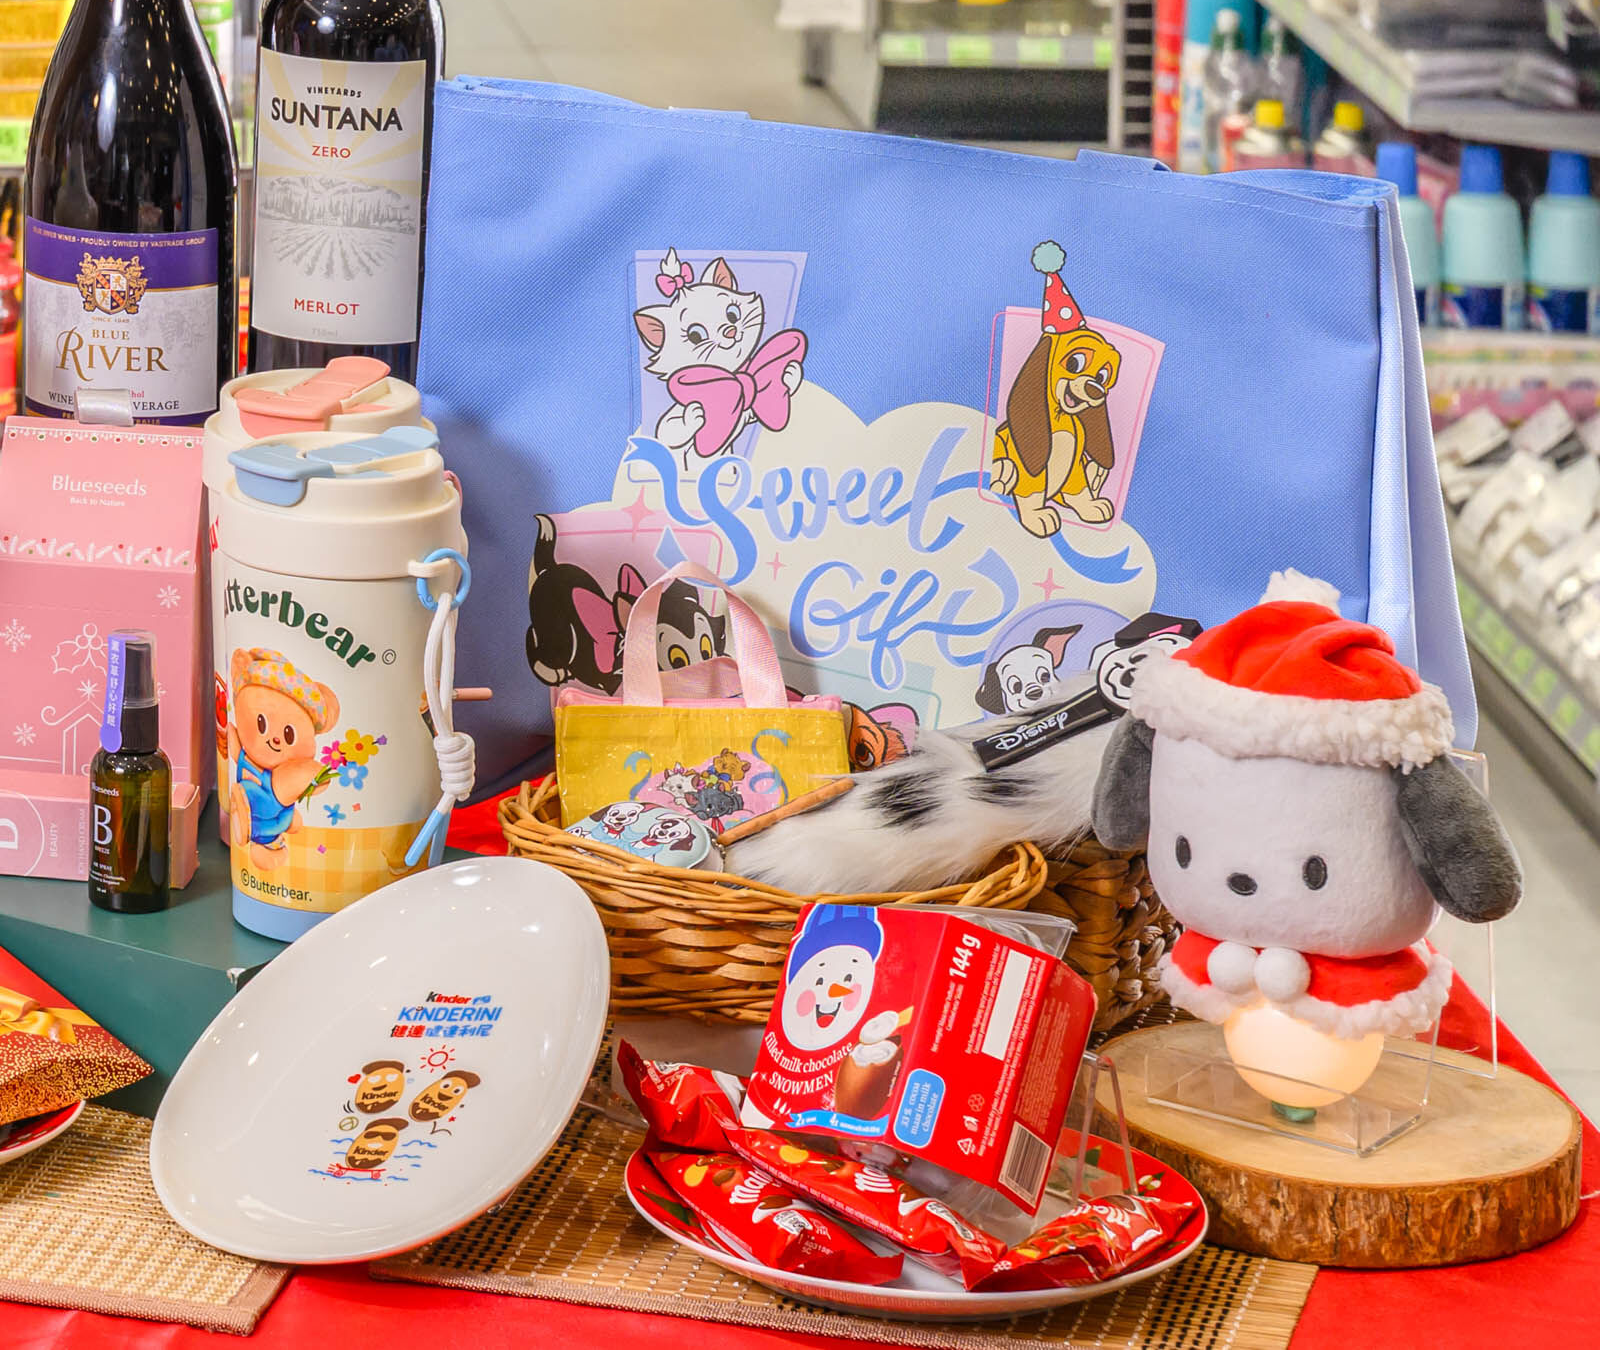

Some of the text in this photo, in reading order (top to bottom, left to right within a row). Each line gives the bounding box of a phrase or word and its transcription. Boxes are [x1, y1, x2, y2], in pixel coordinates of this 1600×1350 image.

[307, 86, 362, 98] VINEYARDS
[271, 97, 403, 131] SUNTANA
[312, 145, 351, 158] ZERO
[80, 236, 111, 247] PROUDLY
[113, 240, 138, 248] OWNED
[140, 240, 149, 248] BY
[185, 236, 206, 246] GROUP
[294, 298, 360, 316] MERLOT
[92, 329, 130, 341] BLUE
[56, 326, 170, 382] RIVER
[48, 391, 180, 411] WINE VERAGE
[51, 473, 148, 497] Blueseeds
[624, 427, 972, 587] Sweet
[224, 578, 377, 668] tterbear
[788, 548, 1020, 690] Gift
[986, 712, 1068, 750] Disney
[50, 822, 58, 858] BEAUTY
[94, 804, 113, 846] B
[949, 934, 981, 979] 144 g
[765, 1031, 854, 1074] filled milk chocolate
[362, 1090, 398, 1100] Kinder
[768, 1071, 834, 1096] SNOWMEN
[420, 1093, 449, 1111] Kinder
[910, 1116, 919, 1135] mass
[919, 1082, 932, 1106] milk
[921, 1093, 938, 1132] chocolate
[353, 1145, 388, 1157] Kinder
